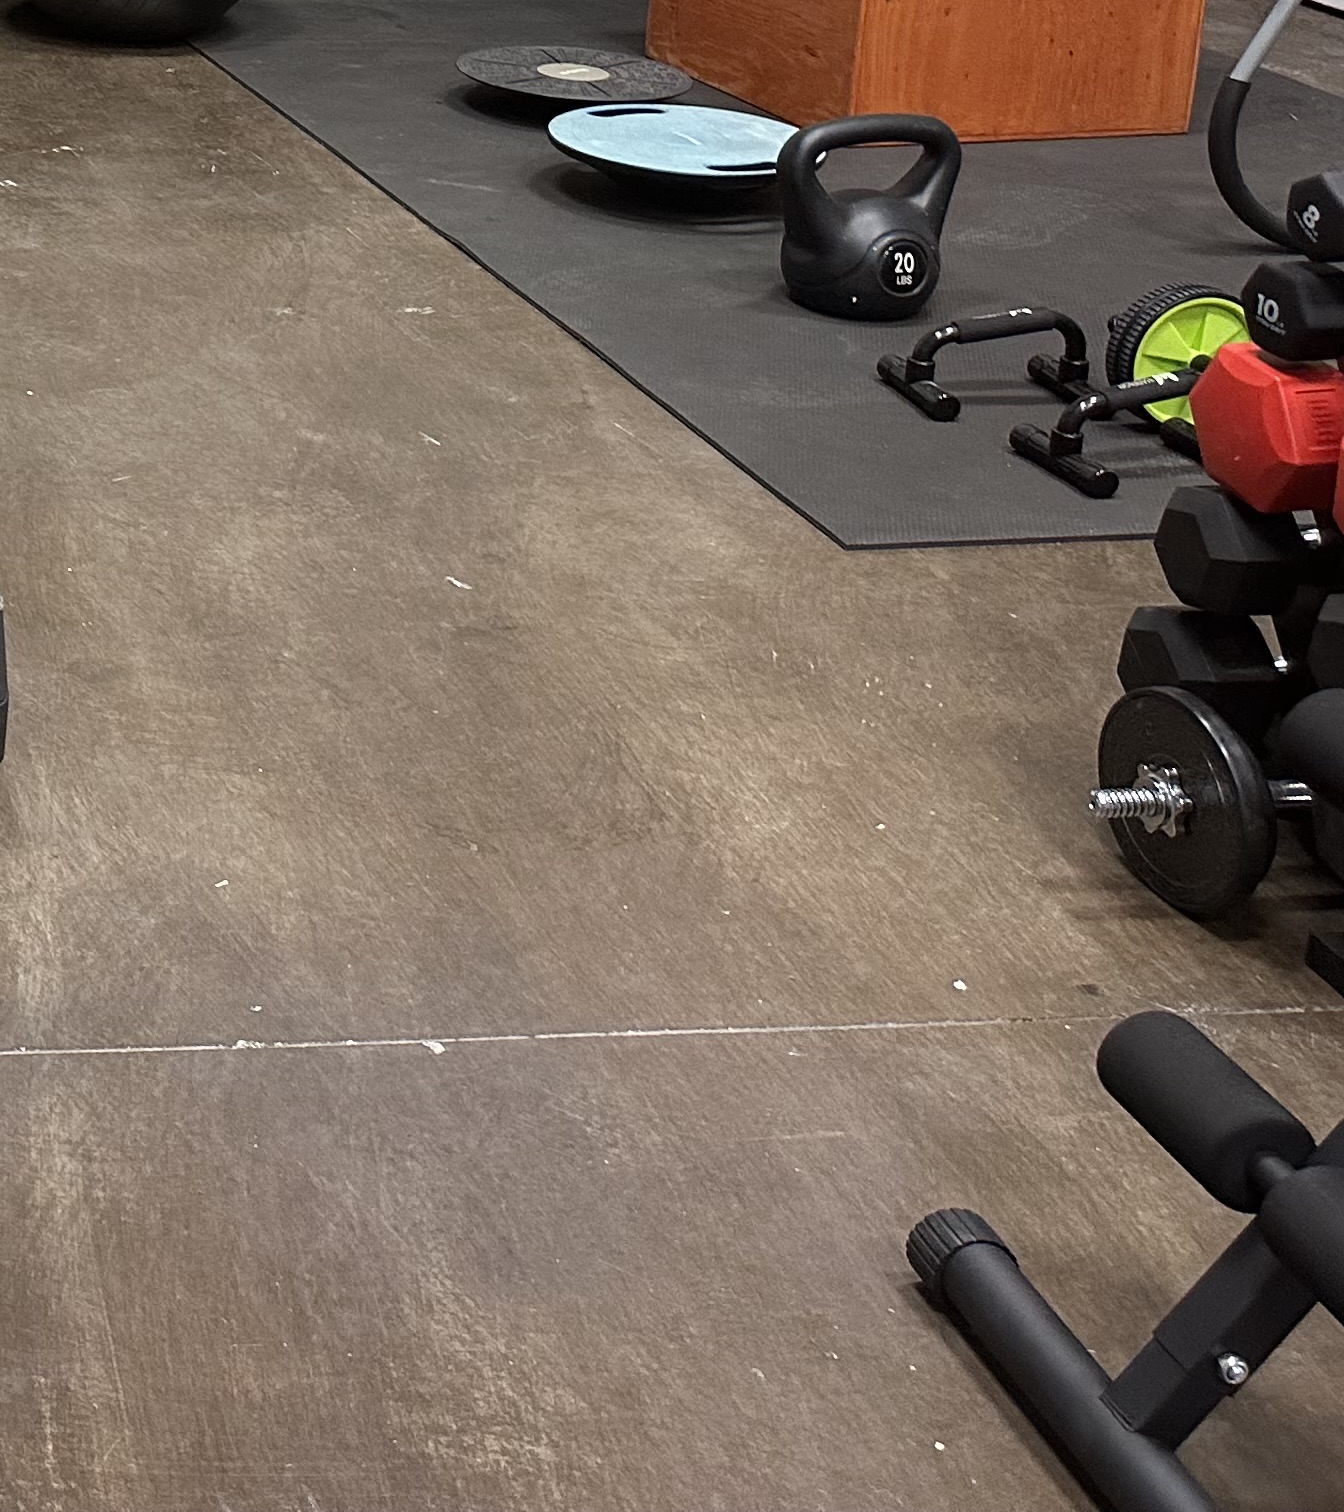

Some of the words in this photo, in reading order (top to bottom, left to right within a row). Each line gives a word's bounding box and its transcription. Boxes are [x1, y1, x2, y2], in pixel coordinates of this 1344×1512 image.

[1303, 204, 1320, 229] 8
[894, 252, 915, 273] 20
[896, 275, 912, 285] LBS
[1257, 293, 1279, 323] 10
